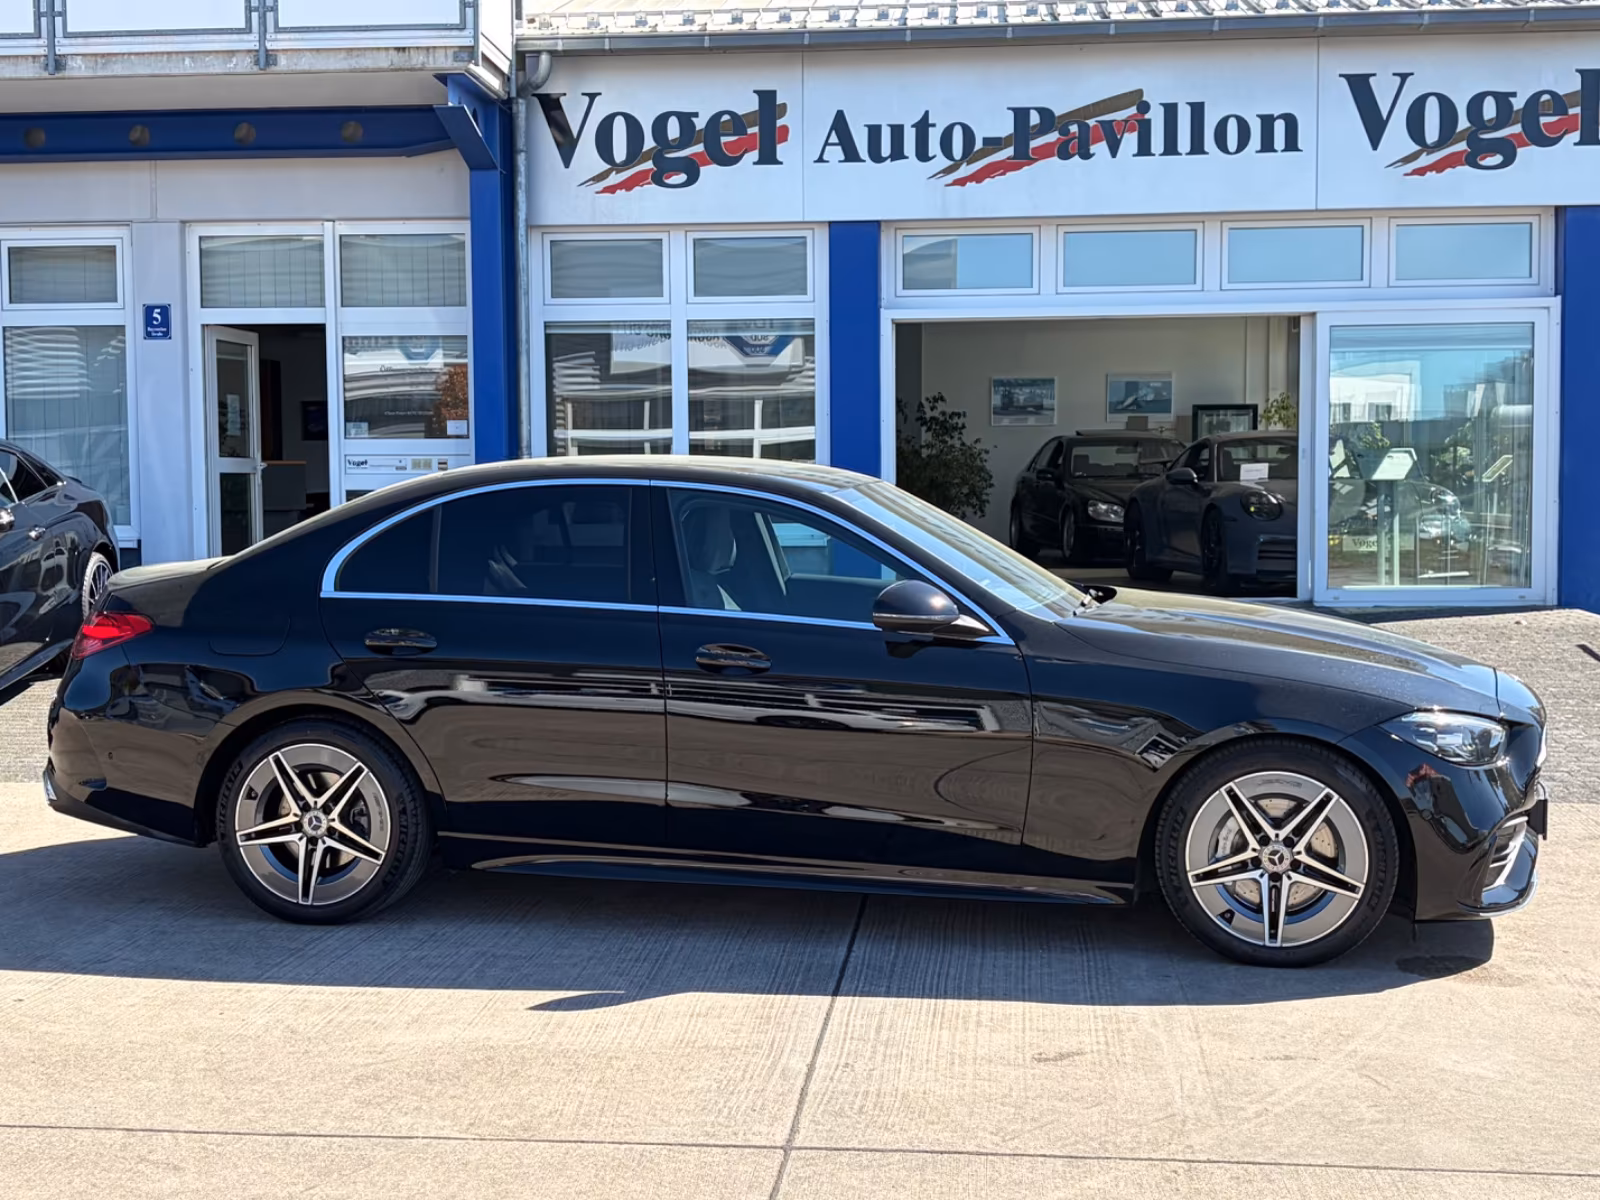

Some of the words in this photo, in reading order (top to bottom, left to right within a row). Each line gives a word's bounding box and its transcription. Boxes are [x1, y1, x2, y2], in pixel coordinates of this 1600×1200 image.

[533, 89, 784, 188] Vogel
[813, 99, 1303, 164] Auto-Pavillon
[1338, 68, 1600, 170] Vogel
[152, 308, 162, 325] 5
